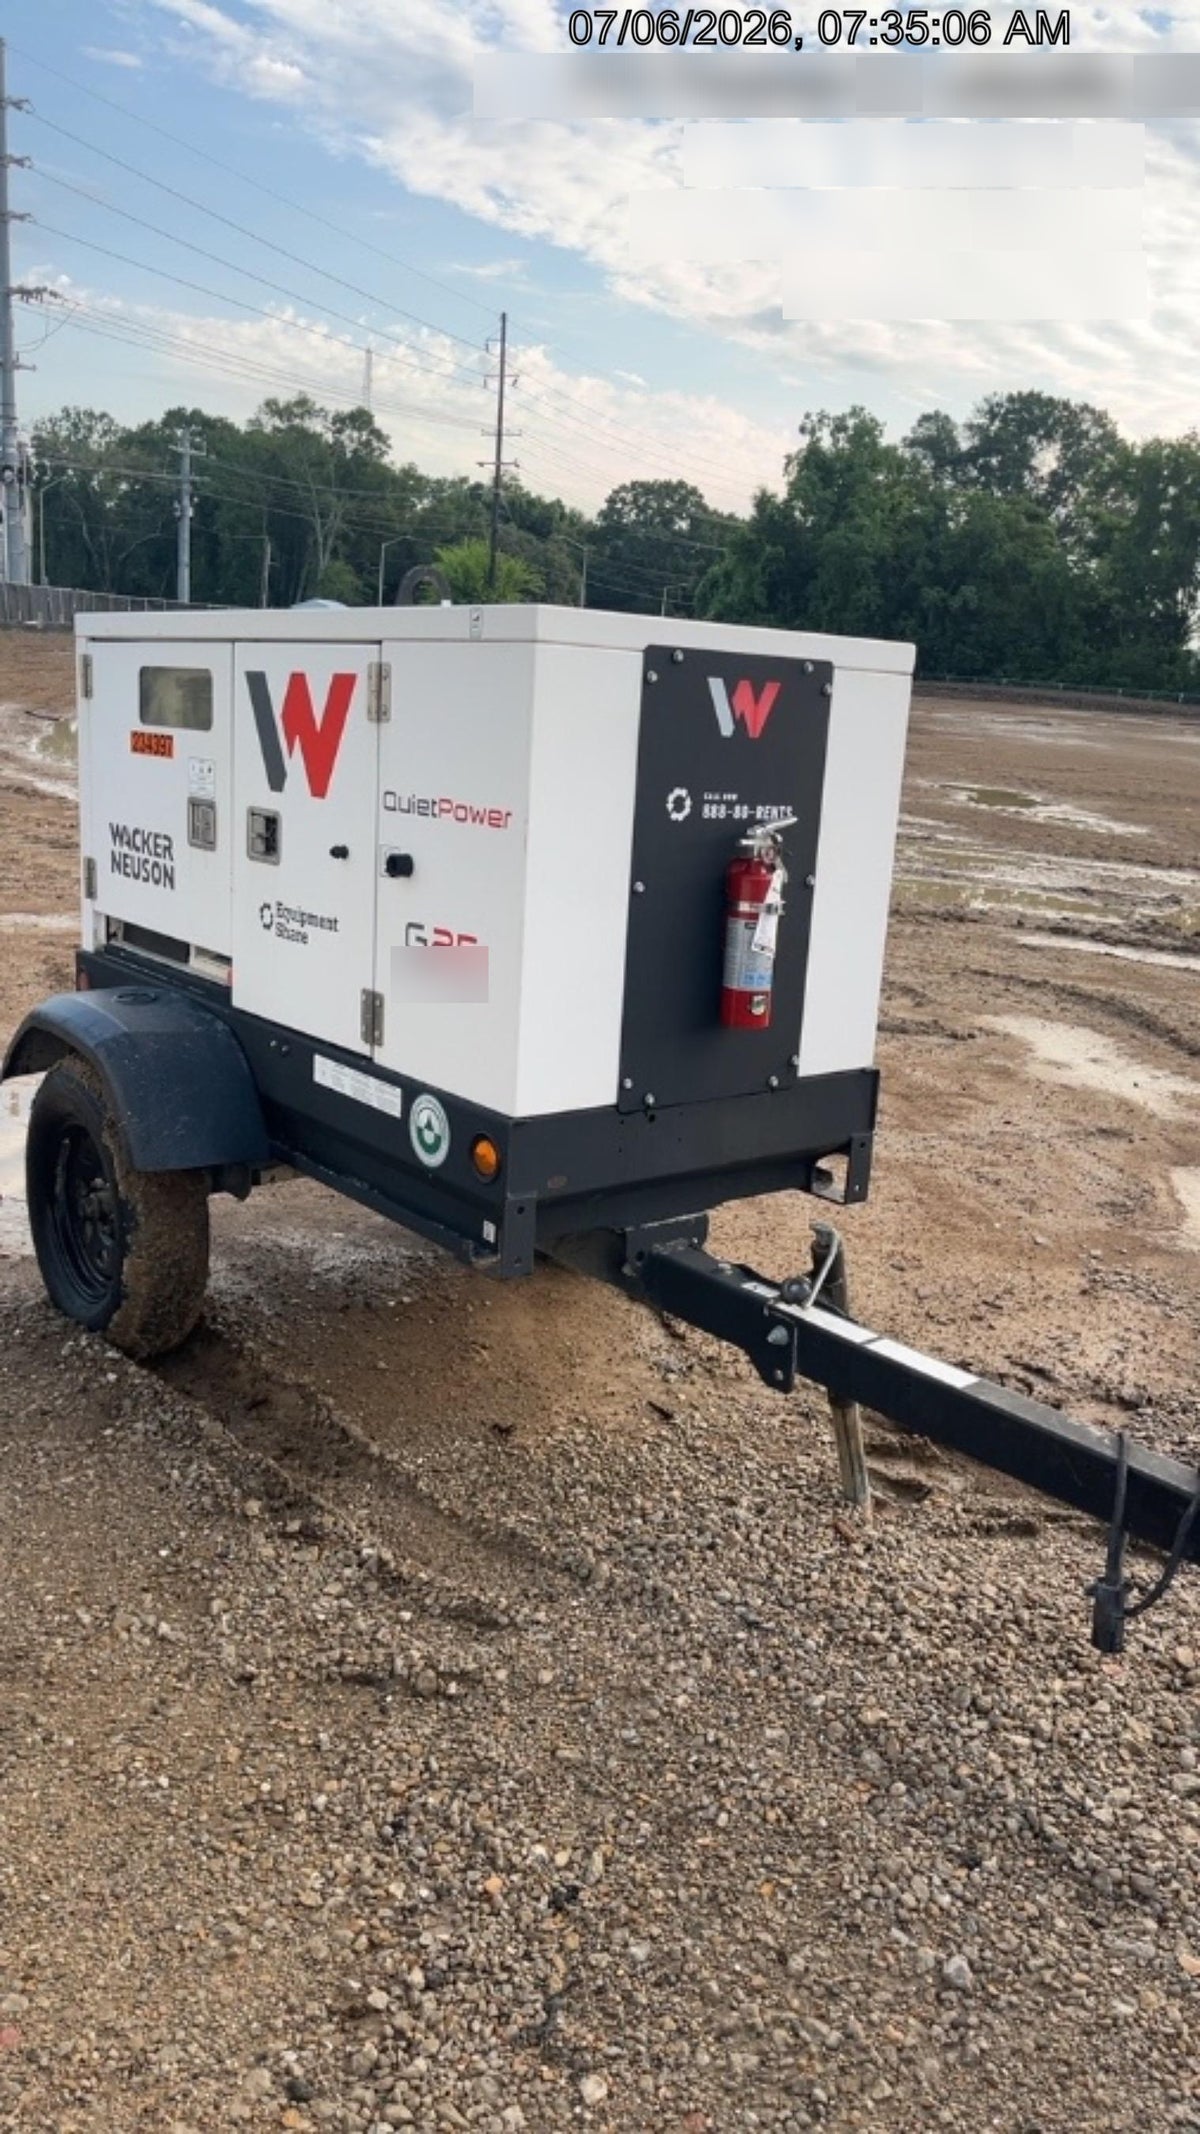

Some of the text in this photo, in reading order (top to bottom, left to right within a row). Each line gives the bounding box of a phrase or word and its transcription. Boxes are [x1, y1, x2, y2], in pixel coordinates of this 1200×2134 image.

[707, 677, 781, 738] W
[244, 670, 358, 799] W
[383, 790, 512, 829] QuietPower
[108, 822, 174, 862] WACKER
[111, 849, 175, 890] NEUSON
[275, 900, 340, 933] Equipment
[275, 921, 309, 945] Share
